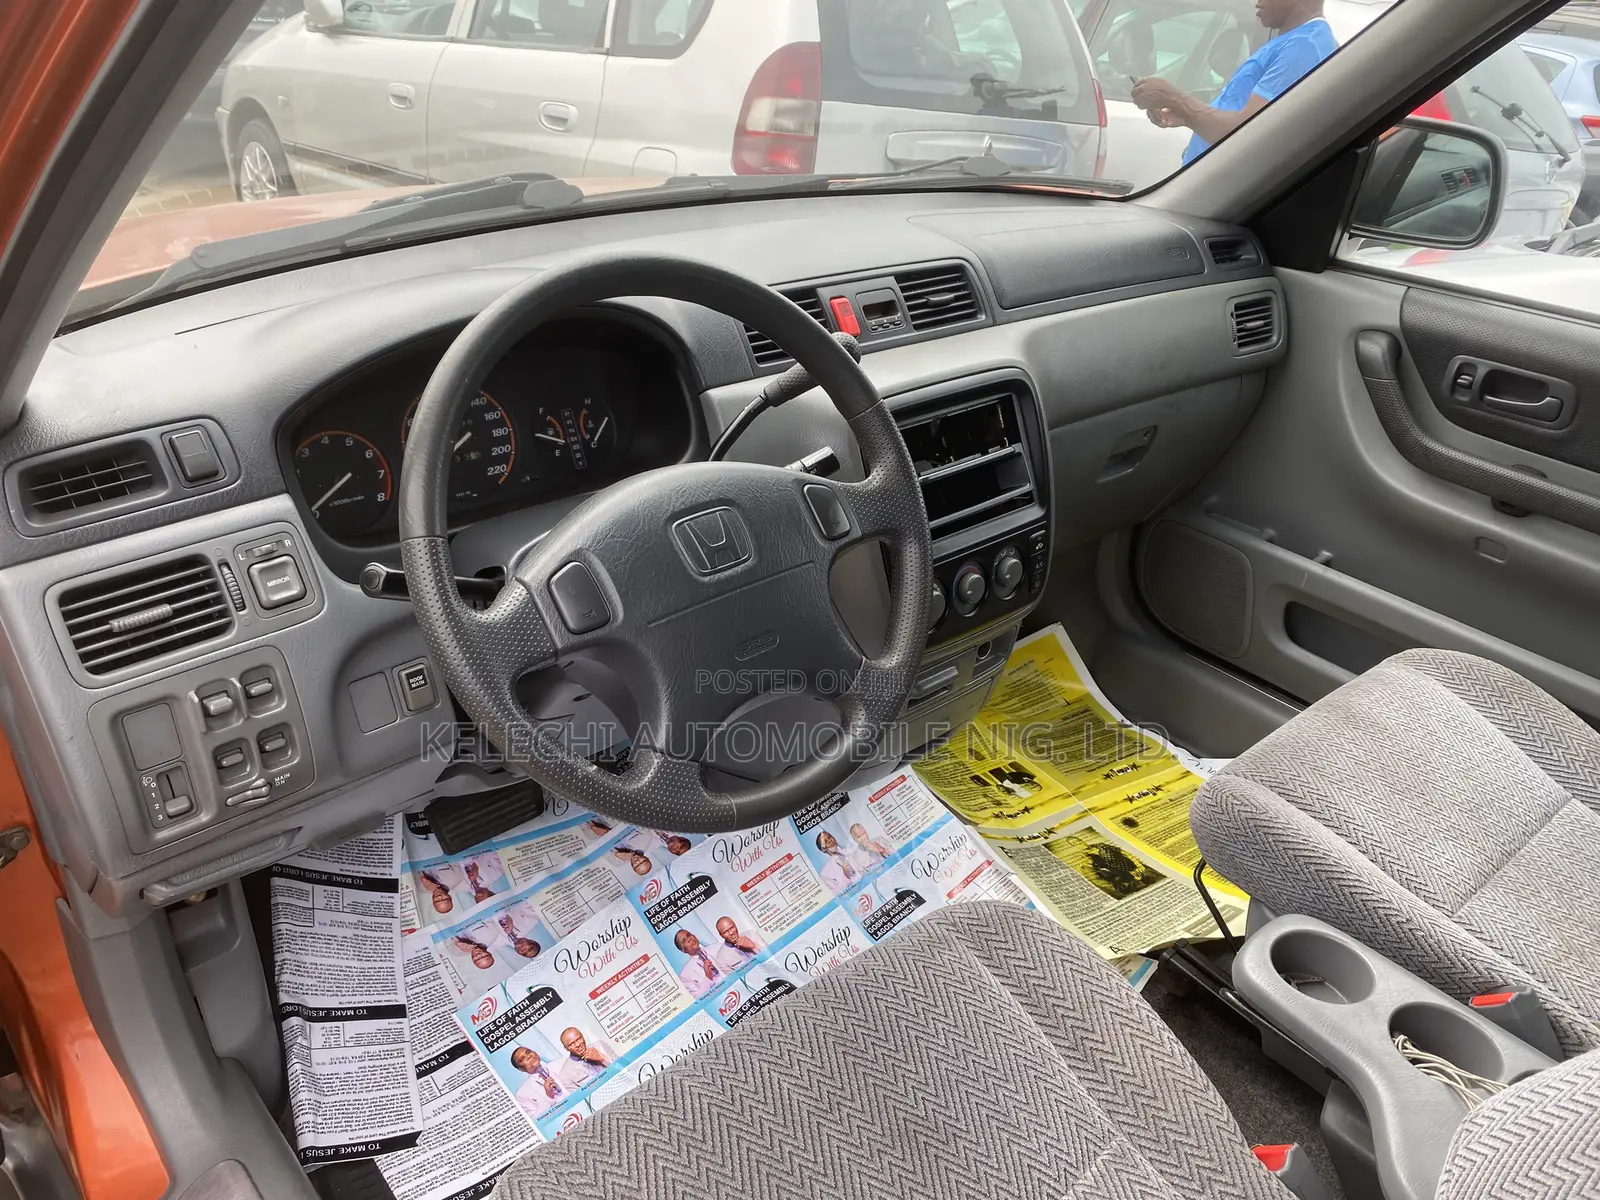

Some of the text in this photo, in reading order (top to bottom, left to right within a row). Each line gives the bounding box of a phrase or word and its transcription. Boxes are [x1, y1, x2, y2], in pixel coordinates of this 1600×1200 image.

[484, 411, 501, 420] 160
[492, 427, 508, 437] 180
[321, 436, 330, 444] 4
[346, 438, 354, 446] 5
[302, 448, 310, 458] 3
[366, 450, 374, 458] 6
[492, 444, 512, 456] 200
[378, 470, 384, 478] 7
[488, 464, 507, 476] 220
[378, 492, 385, 502] 8
[238, 552, 246, 561] L
[266, 576, 290, 588] MIRROR
[410, 674, 424, 684] ROOF
[411, 680, 425, 688] MAIN
[274, 773, 290, 782] MAIN
[795, 806, 821, 826] GOSPEL
[798, 801, 842, 832] LAGOS BRANCH
[410, 820, 429, 828] MBLY
[712, 821, 780, 864] Worship
[730, 833, 784, 873] With Us
[911, 833, 968, 879] Worship
[282, 867, 304, 877] LORD
[305, 872, 330, 880] JESUS
[332, 874, 352, 884] MAKE
[746, 872, 765, 887] WEEKLY
[645, 884, 690, 917] LIFE OF FAITH
[650, 880, 711, 924] GOSPEL ASSEMBLY
[654, 894, 706, 932] LAGOS BRANCH
[861, 897, 898, 927] LIFE OF FAITH
[867, 892, 916, 934] GOSPEL ASSEMBLY
[872, 903, 915, 939] LAGOS BRANCH
[554, 916, 632, 972] Worship
[784, 926, 851, 972] Worship
[578, 934, 638, 978] With Us
[838, 943, 860, 960] Us
[595, 957, 644, 994] WEEKLY ACTIVITIES
[758, 982, 790, 1005] ASSEMBLY
[727, 1009, 743, 1025] LIFE
[741, 1000, 752, 1012] OF
[751, 986, 769, 1002] FAITH
[302, 1008, 328, 1016] JESUS
[477, 998, 530, 1037] LIFE OF FAITH
[482, 990, 554, 1044] GOSPEL ASSEMBLY
[488, 1006, 547, 1051] LAGOS BRANCH
[438, 1054, 450, 1062] TO
[306, 1148, 336, 1158] JESUS
[338, 1144, 366, 1153] MAKE
[449, 1188, 474, 1200] JESU
